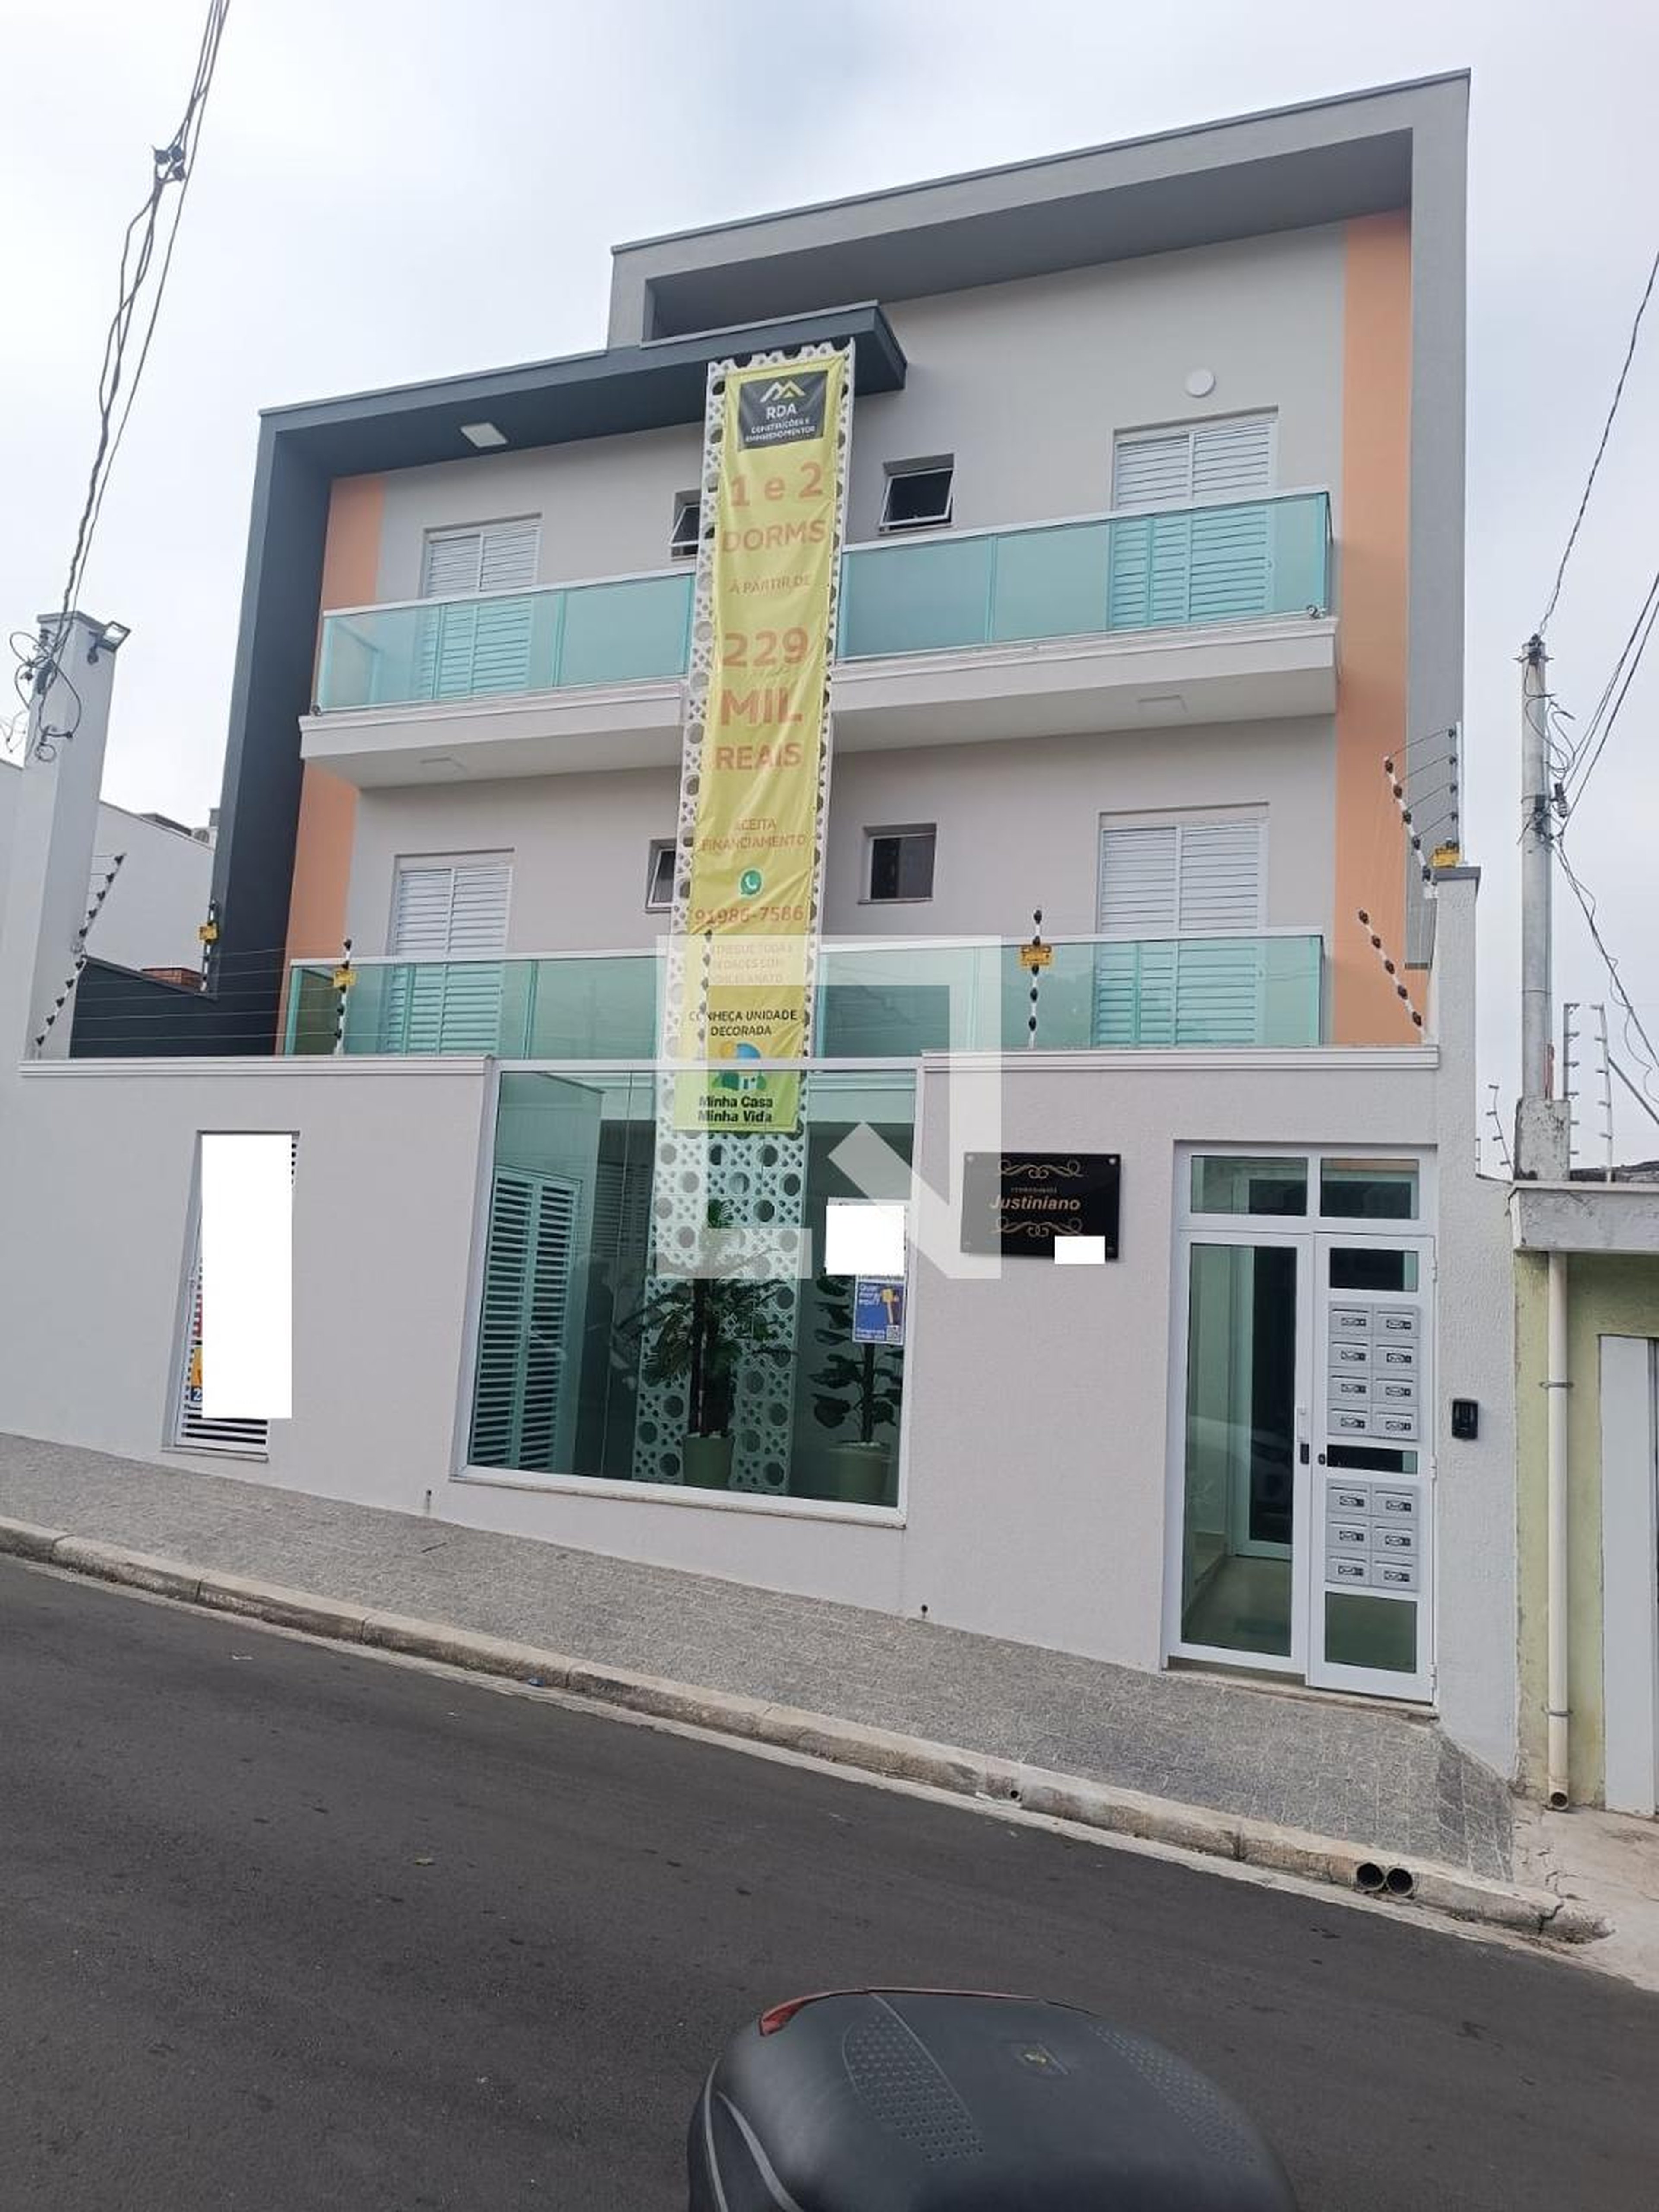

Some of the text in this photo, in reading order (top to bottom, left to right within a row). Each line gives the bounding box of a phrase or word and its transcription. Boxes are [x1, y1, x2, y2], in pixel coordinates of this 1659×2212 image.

[767, 403, 796, 420] RDA
[731, 462, 823, 507] 1 e 2
[722, 519, 826, 553] DORMS
[743, 575, 790, 593] PARTIR
[793, 574, 810, 587] DE
[722, 627, 809, 668] 229
[720, 686, 803, 727] MIL
[715, 742, 802, 771] REAIS
[738, 818, 777, 831] CEITA
[701, 834, 806, 851] FINANCIAMENTO
[746, 1009, 798, 1020] UNIDADE
[711, 1025, 772, 1036] DECORADA
[699, 1095, 773, 1108] Minha Casa
[698, 1110, 772, 1122] Minha Vida
[990, 1195, 1081, 1210] Justiniano
